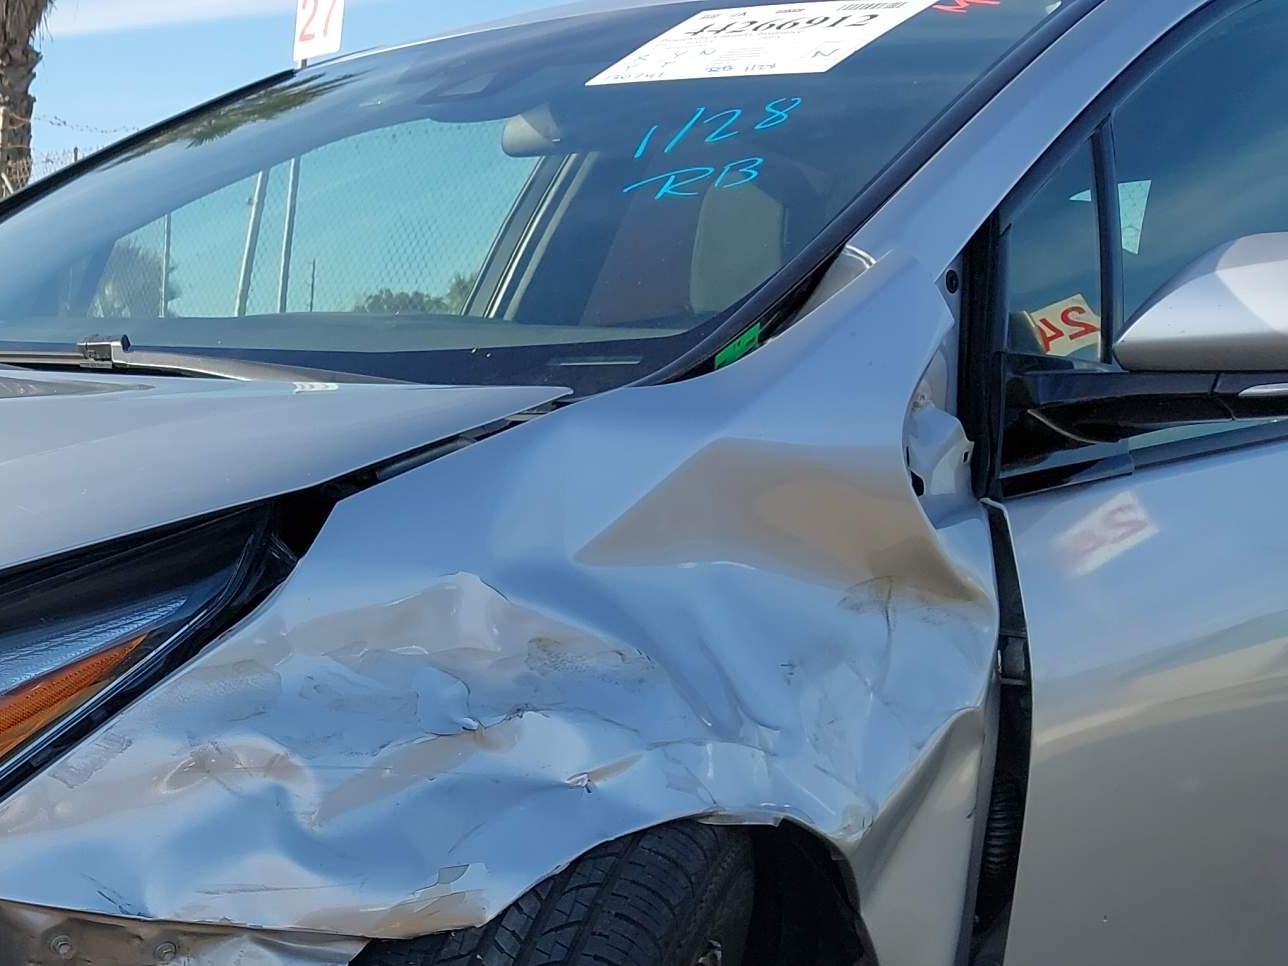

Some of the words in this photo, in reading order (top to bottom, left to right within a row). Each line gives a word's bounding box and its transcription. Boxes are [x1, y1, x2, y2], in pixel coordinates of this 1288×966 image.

[298, 0, 336, 41] 27
[686, 14, 879, 36] 44266912
[634, 97, 802, 158] 1/28
[623, 157, 763, 199] RB
